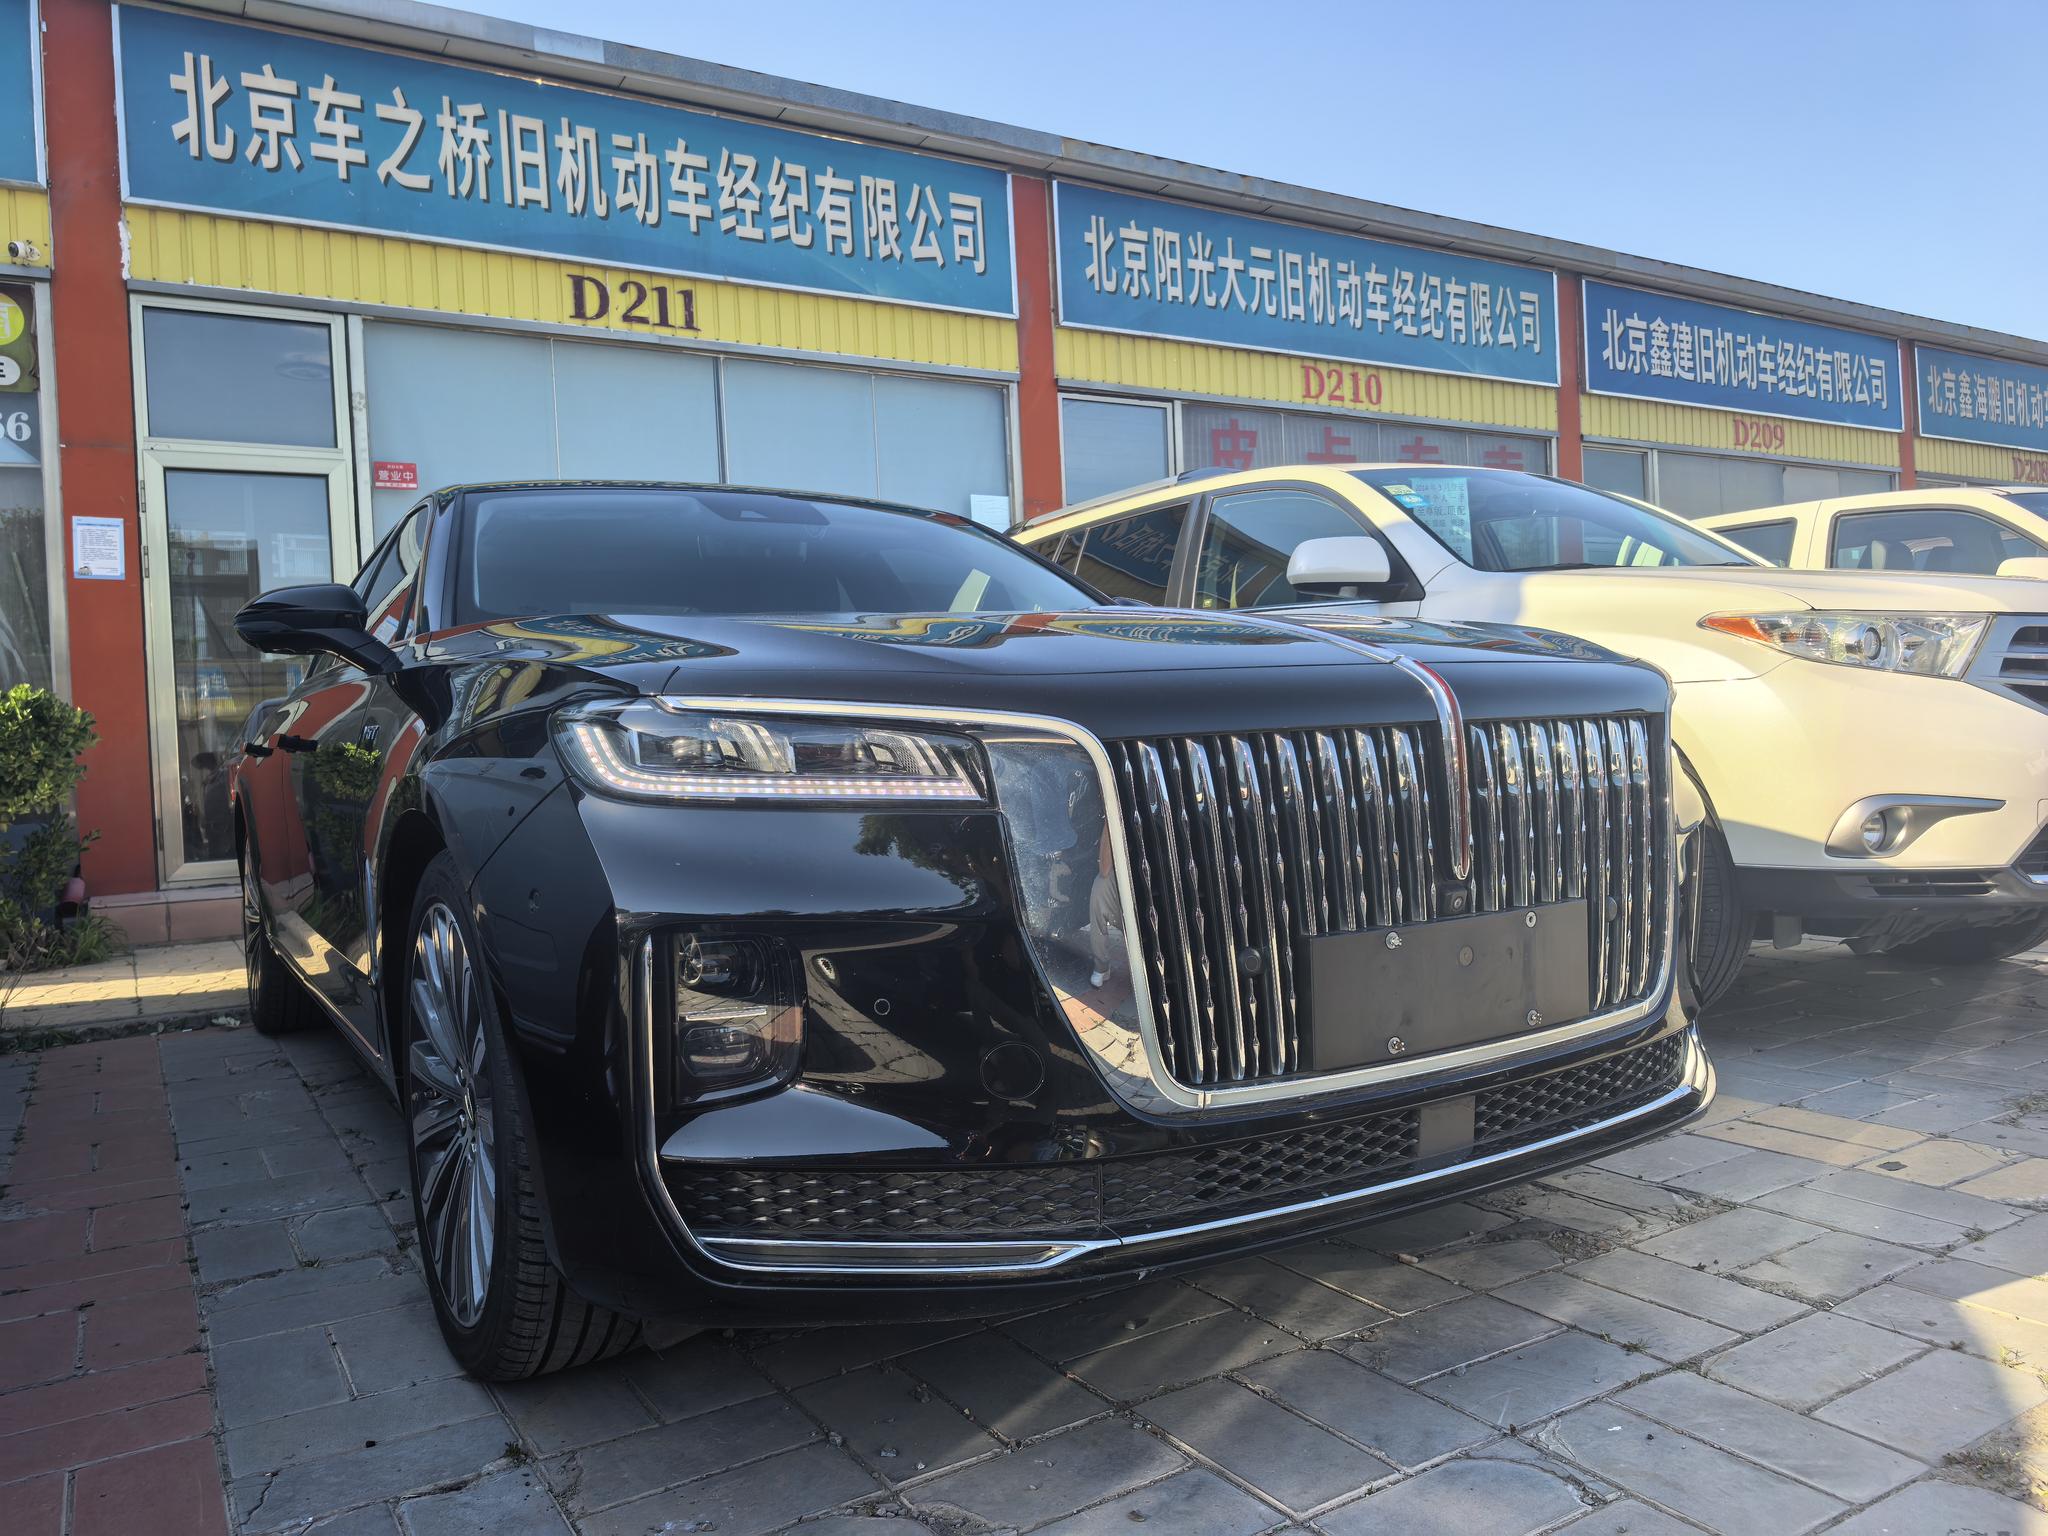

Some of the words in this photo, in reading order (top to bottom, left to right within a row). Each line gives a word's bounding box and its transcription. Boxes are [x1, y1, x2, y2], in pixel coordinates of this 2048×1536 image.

[169, 51, 986, 274] 北京车之桥旧机动车经纪有限公司
[566, 273, 701, 331] D211
[1084, 215, 1541, 353] 北京阳光大元旧机动车经纪有限公司
[1601, 308, 1888, 410] 北京鑫建旧机动车经纪有限公司
[1301, 365, 1383, 405] D210
[0, 411, 31, 441] 6
[1733, 419, 1786, 450] D209
[378, 470, 414, 481] 营业中
